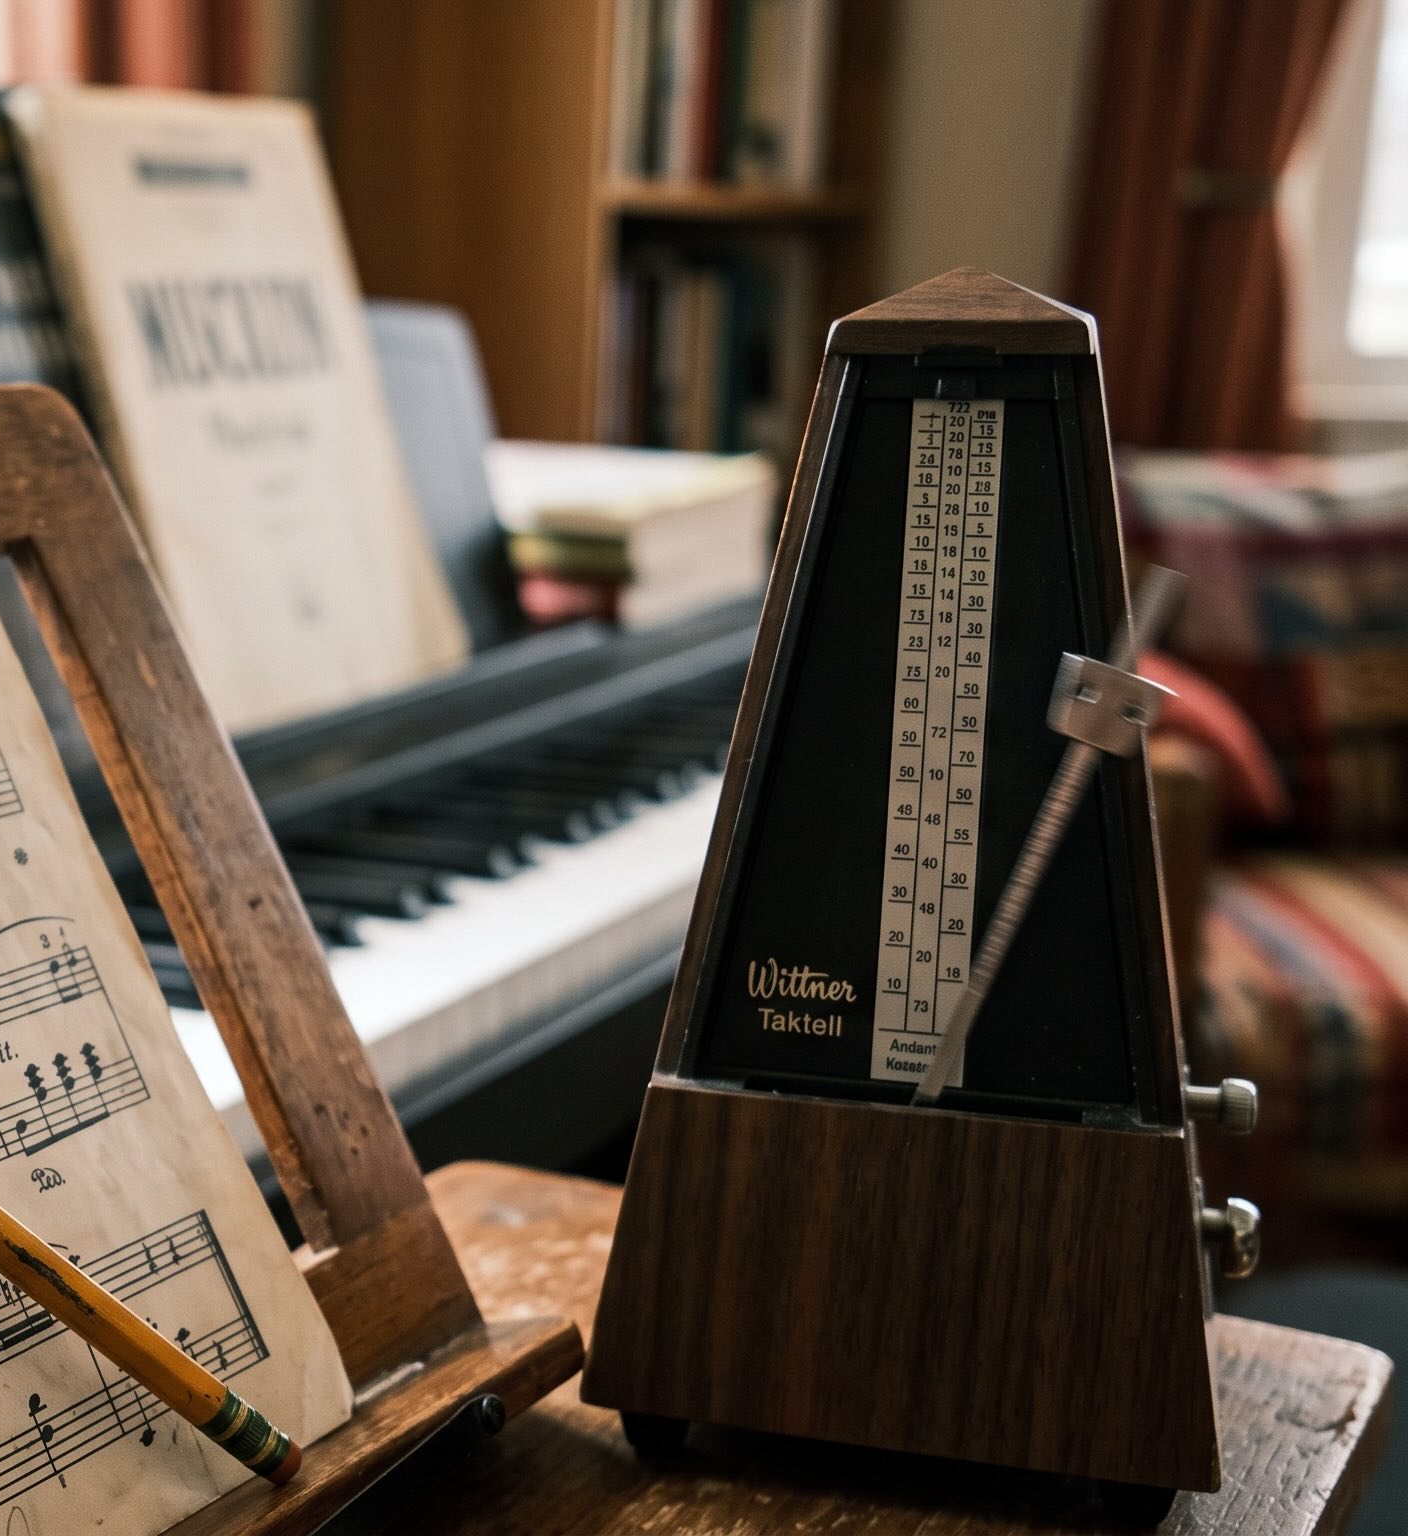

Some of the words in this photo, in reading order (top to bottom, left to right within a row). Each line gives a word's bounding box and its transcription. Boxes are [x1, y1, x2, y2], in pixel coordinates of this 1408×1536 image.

[947, 402, 970, 413] 722
[949, 416, 965, 427] 20
[979, 425, 994, 436] 15
[949, 432, 964, 443] 20
[948, 448, 963, 460] 78
[947, 465, 962, 476] 10
[977, 462, 992, 473] 15
[918, 473, 933, 484] 18
[945, 483, 961, 495] 20
[944, 503, 960, 515] 28
[974, 501, 989, 513] 10
[916, 514, 931, 525] 15
[976, 522, 984, 534] 5
[915, 536, 930, 547] 10
[942, 546, 957, 557] 18
[972, 546, 987, 558] 10
[941, 567, 956, 578] 14
[970, 570, 986, 582] 30
[912, 583, 926, 595] 15
[940, 588, 954, 600] 14
[968, 595, 984, 607] 30
[910, 609, 925, 621] 75
[938, 611, 953, 623] 18
[967, 623, 983, 634] 30
[908, 636, 924, 648] 23
[937, 635, 952, 647] 12
[965, 651, 981, 663] 40
[907, 665, 921, 677] 75
[935, 665, 950, 678] 20
[963, 683, 979, 695] 50
[903, 697, 919, 709] 60
[961, 716, 977, 728] 50
[901, 730, 917, 742] 50
[931, 726, 947, 738] 72
[959, 751, 975, 763] 70
[899, 766, 915, 778] 50
[928, 769, 944, 781] 10
[956, 788, 972, 800] 50
[897, 804, 913, 816] 48
[924, 813, 941, 825] 48
[953, 829, 970, 840] 55
[894, 844, 910, 855] 40
[921, 857, 938, 869] 40
[950, 872, 967, 884] 30
[891, 886, 907, 898] 30
[919, 902, 935, 914] 48
[948, 919, 964, 930] 20
[888, 931, 904, 943] 20
[915, 950, 932, 963] 20
[945, 967, 961, 979] 18
[748, 957, 857, 1003] Wittner
[887, 978, 901, 989] 10
[913, 1000, 929, 1013] 73
[758, 1007, 842, 1037] Taktell
